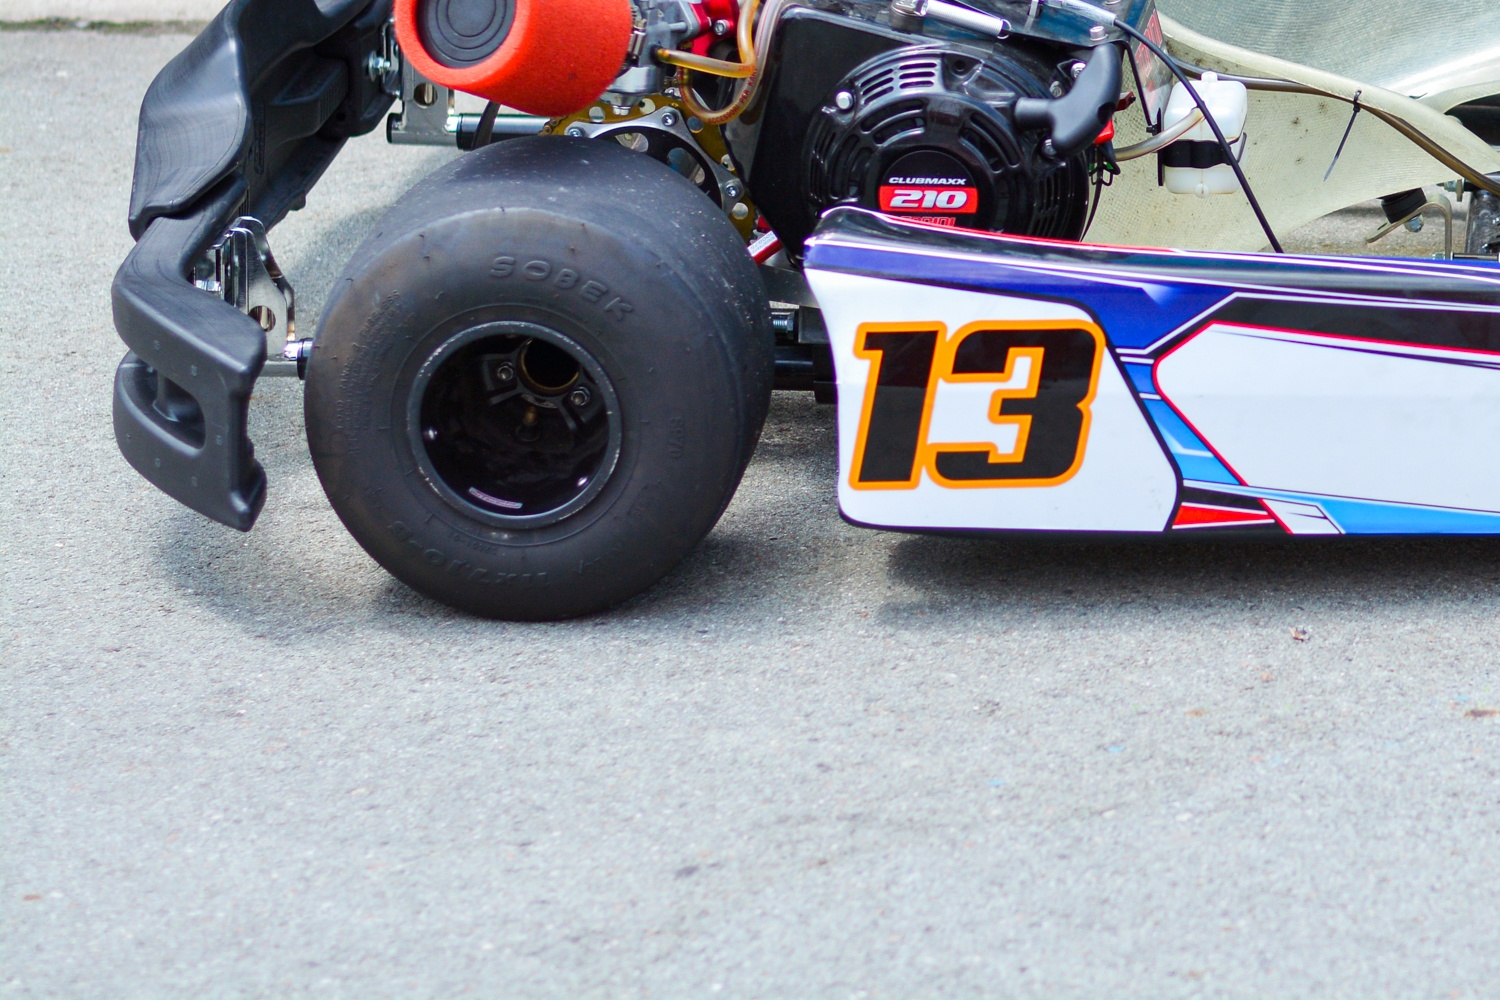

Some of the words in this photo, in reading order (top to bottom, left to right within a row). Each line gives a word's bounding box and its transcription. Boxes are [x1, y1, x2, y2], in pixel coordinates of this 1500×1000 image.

[889, 177, 967, 185] CLUBMAXX
[890, 189, 967, 208] 210
[488, 255, 635, 321] SOBEK
[851, 320, 1106, 491] 13
